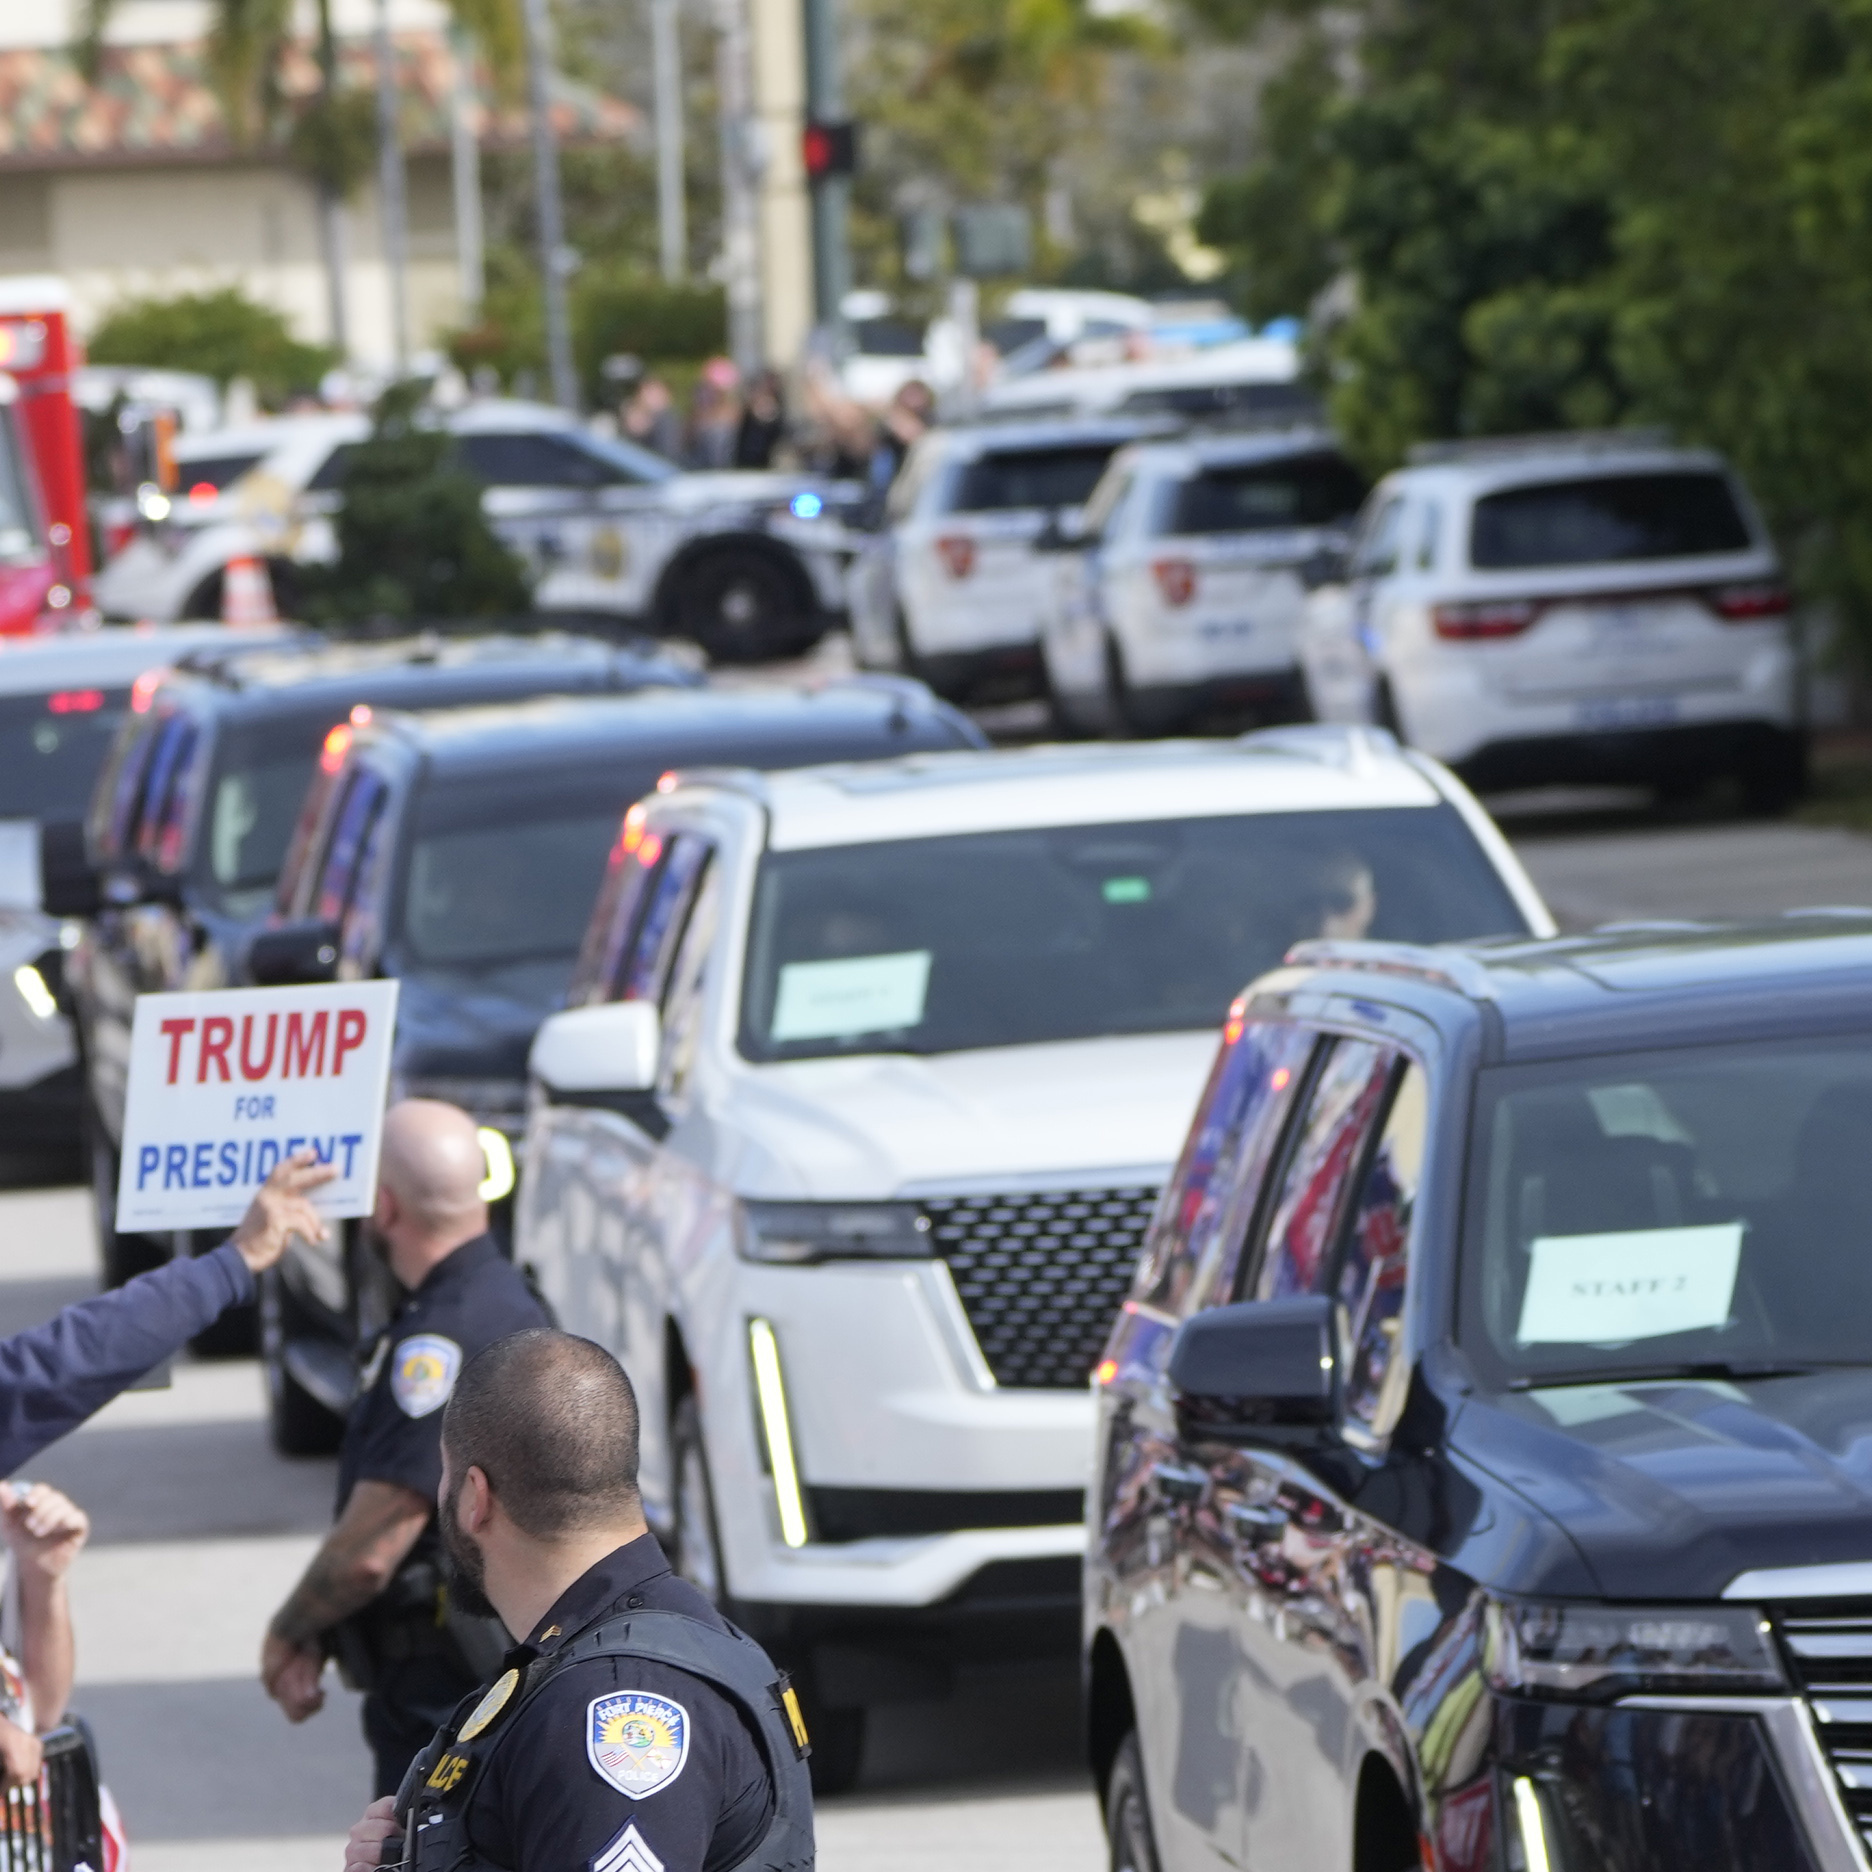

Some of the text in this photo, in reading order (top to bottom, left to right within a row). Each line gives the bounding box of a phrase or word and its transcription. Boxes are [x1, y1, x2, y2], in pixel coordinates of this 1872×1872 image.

[160, 1009, 367, 1085] TRUMP
[234, 1094, 276, 1121] FOR
[1572, 1277, 1665, 1298] STAFF
[597, 1702, 681, 1727] FORT PIERCE
[616, 1770, 660, 1782] POLICE
